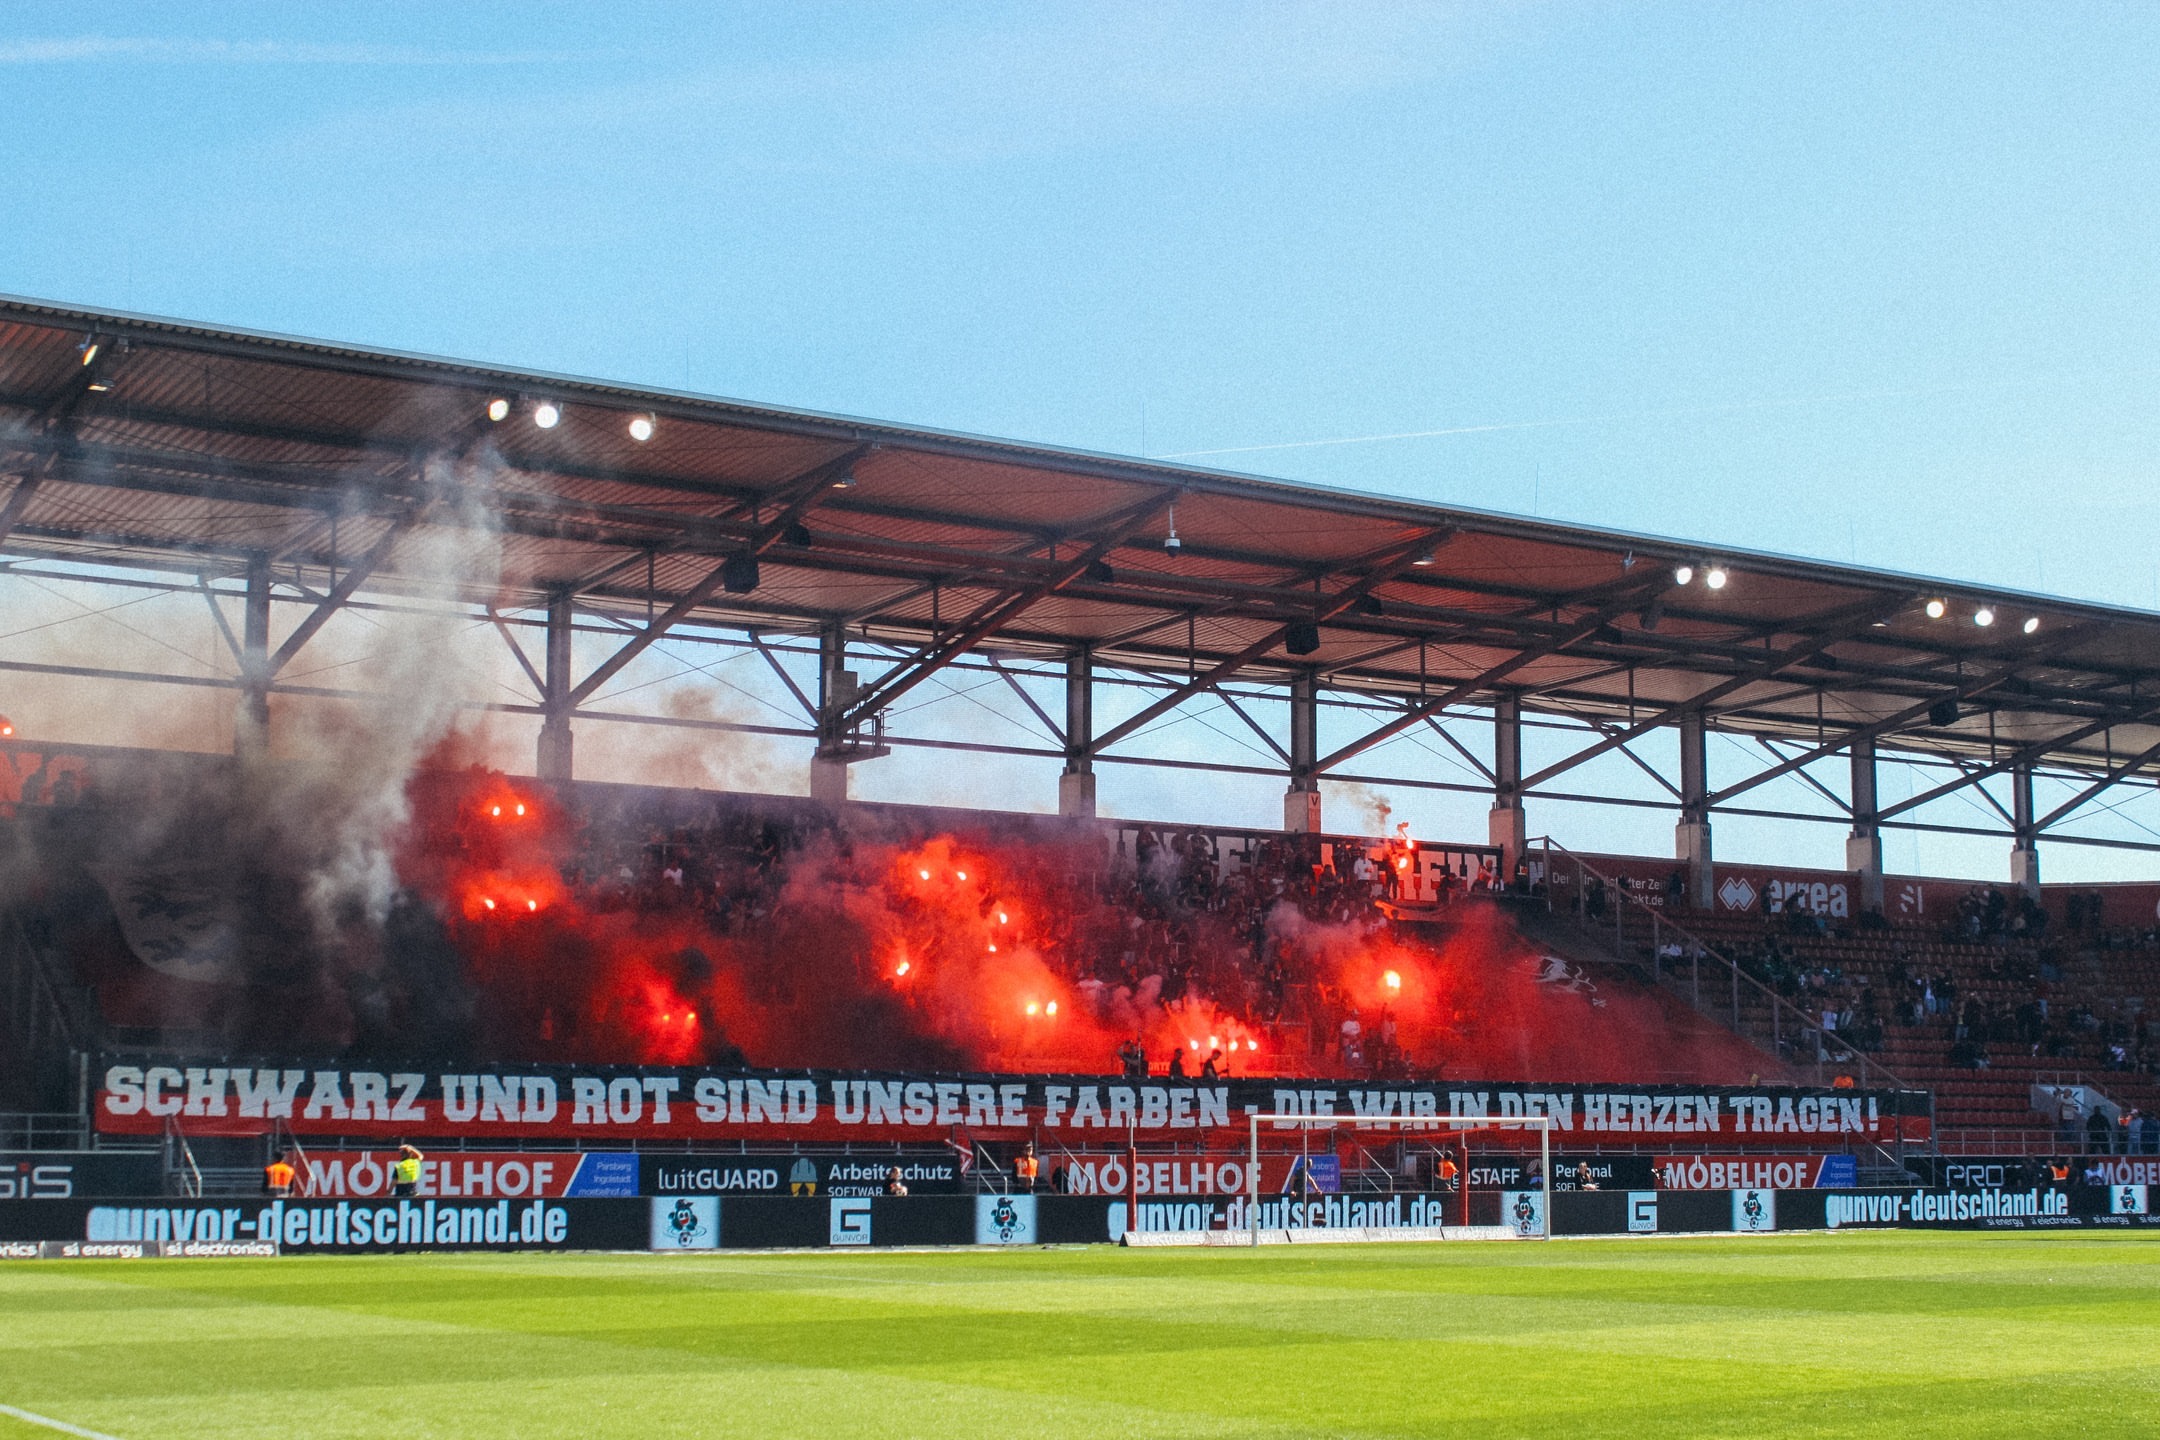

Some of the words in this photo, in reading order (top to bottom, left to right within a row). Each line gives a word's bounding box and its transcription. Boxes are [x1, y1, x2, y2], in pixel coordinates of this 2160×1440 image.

[104, 1065, 426, 1121] SCHWARZ
[440, 1073, 558, 1123] UND
[571, 1075, 679, 1124] ROT
[693, 1077, 817, 1124] SIND
[831, 1079, 1028, 1127] UNSERE
[1043, 1084, 1230, 1129] FARBEN
[1273, 1088, 1338, 1131] DIE
[1348, 1089, 1438, 1131] WIR
[1449, 1091, 1489, 1130] IN
[1498, 1092, 1574, 1132] DEN
[1583, 1093, 1721, 1133] HERZEN
[1729, 1095, 1879, 1134] TRAGEN!
[309, 1151, 553, 1197] MÖELHOF
[658, 1167, 778, 1191] luitGUARD
[1067, 1154, 1262, 1194] MÖBELHOF
[1555, 1163, 1613, 1178] Peronal
[1665, 1155, 1807, 1189] MÖBELHOF
[827, 1186, 884, 1197] SOFTWAR
[1107, 1194, 1443, 1241] nvor-deutschland.de
[81, 1244, 143, 1258] energy
[184, 1240, 274, 1256] electronics
